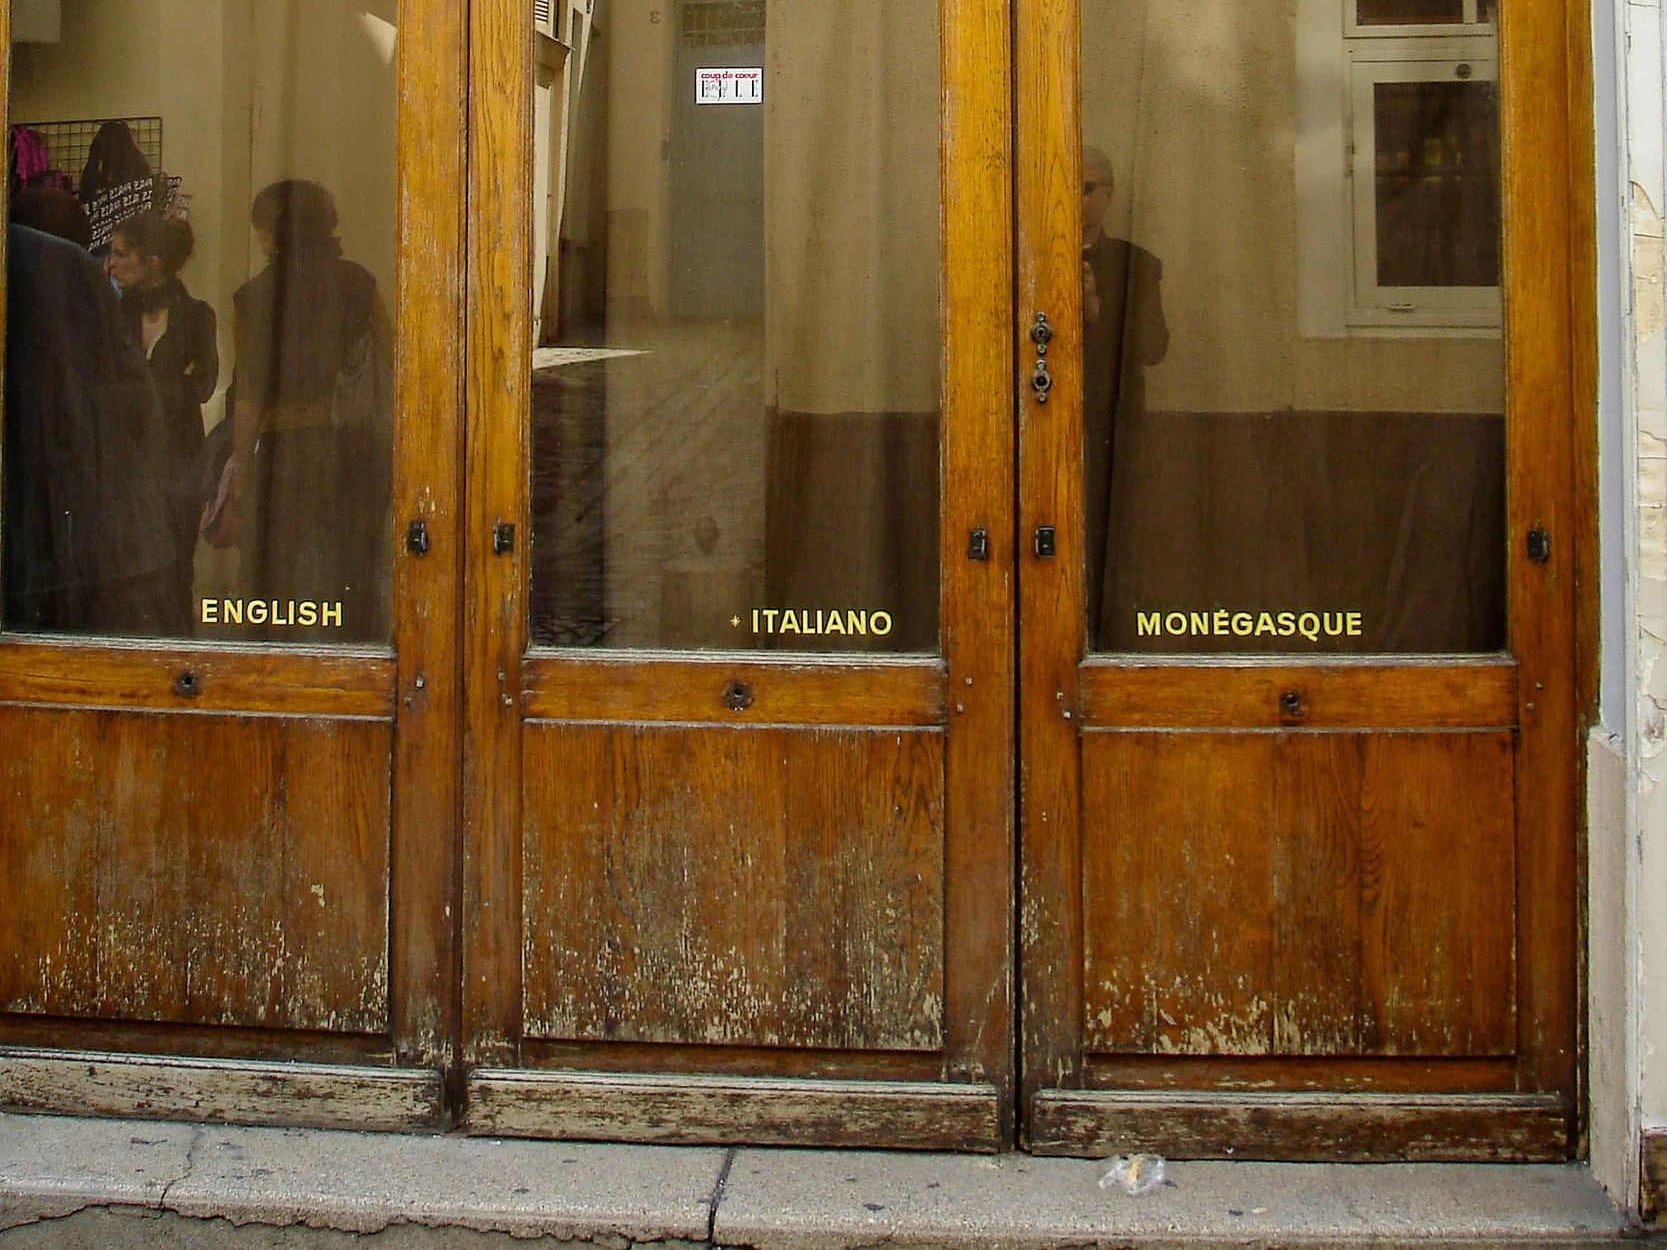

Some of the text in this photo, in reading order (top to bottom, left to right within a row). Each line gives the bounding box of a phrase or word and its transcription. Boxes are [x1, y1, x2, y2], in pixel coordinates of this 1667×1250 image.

[701, 72, 721, 81] coup
[722, 71, 733, 79] de
[201, 598, 342, 627] ENGLISH
[752, 609, 892, 636] ITALIANO
[1137, 609, 1362, 642] MONÉGASQUE
